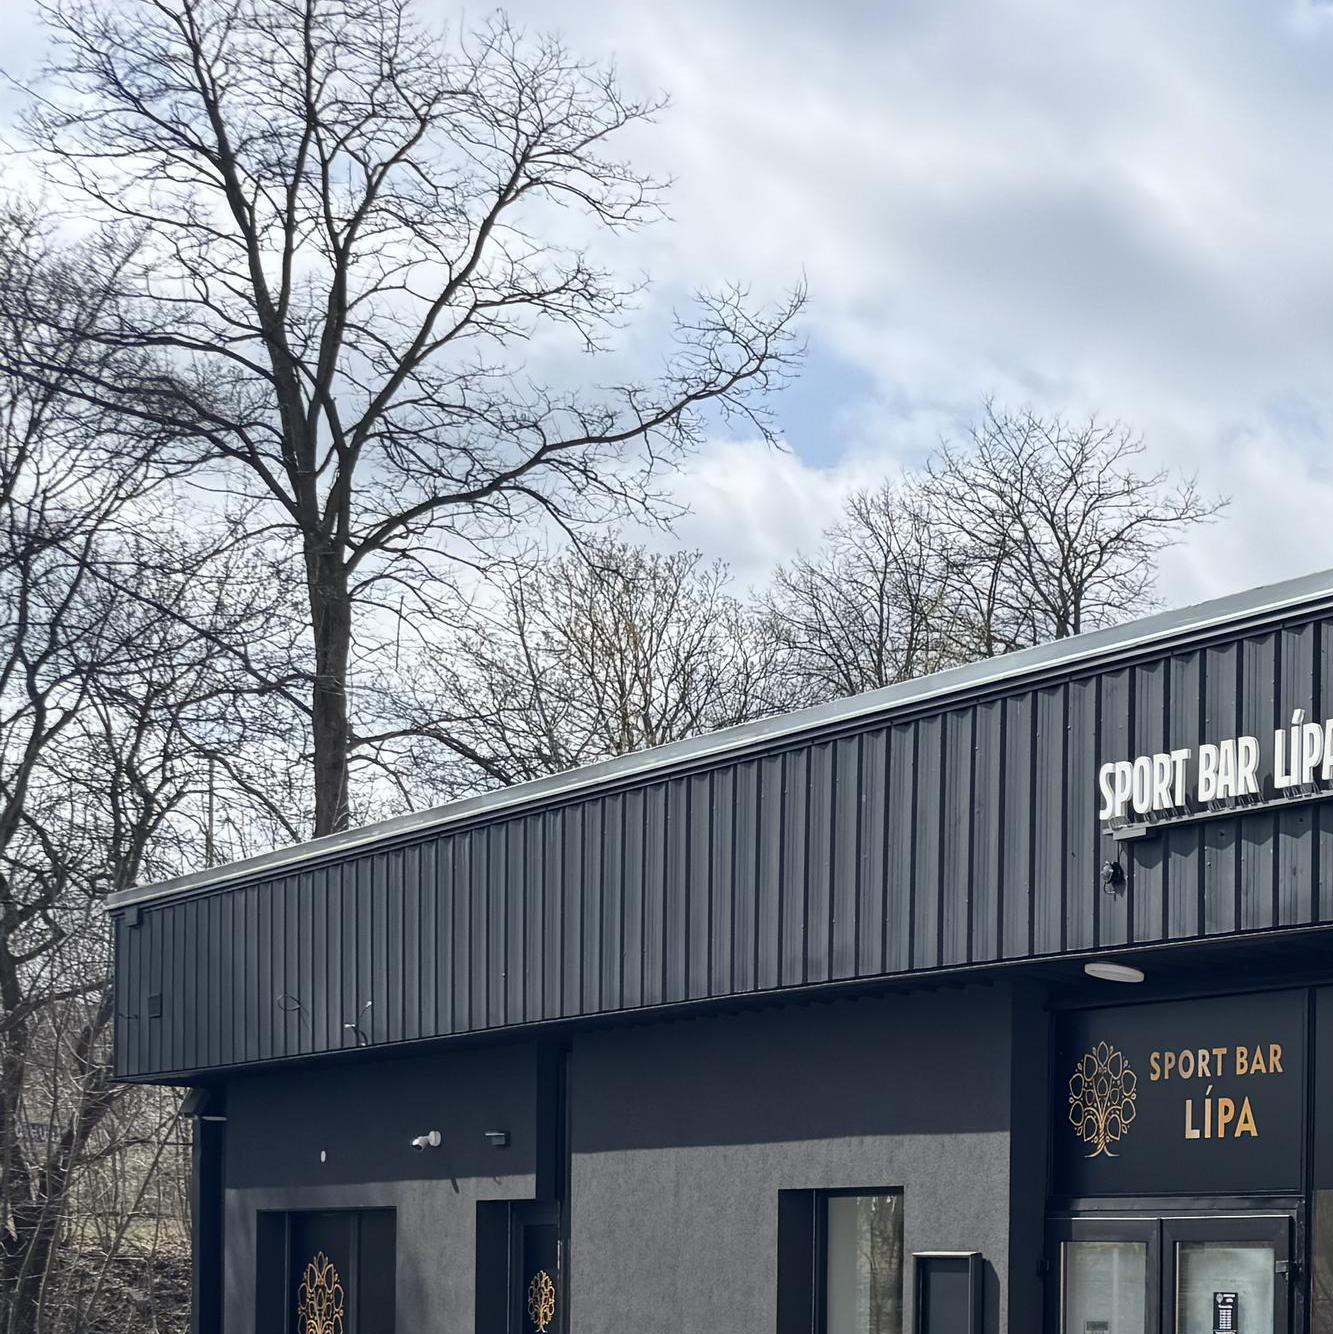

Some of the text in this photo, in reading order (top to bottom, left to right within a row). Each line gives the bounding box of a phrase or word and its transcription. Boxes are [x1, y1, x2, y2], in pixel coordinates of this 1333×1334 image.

[1099, 748, 1192, 821] SPORT
[1197, 735, 1261, 803] BAR
[1149, 1043, 1284, 1081] SPORT BAR
[1185, 1084, 1258, 1139] LÍPA
